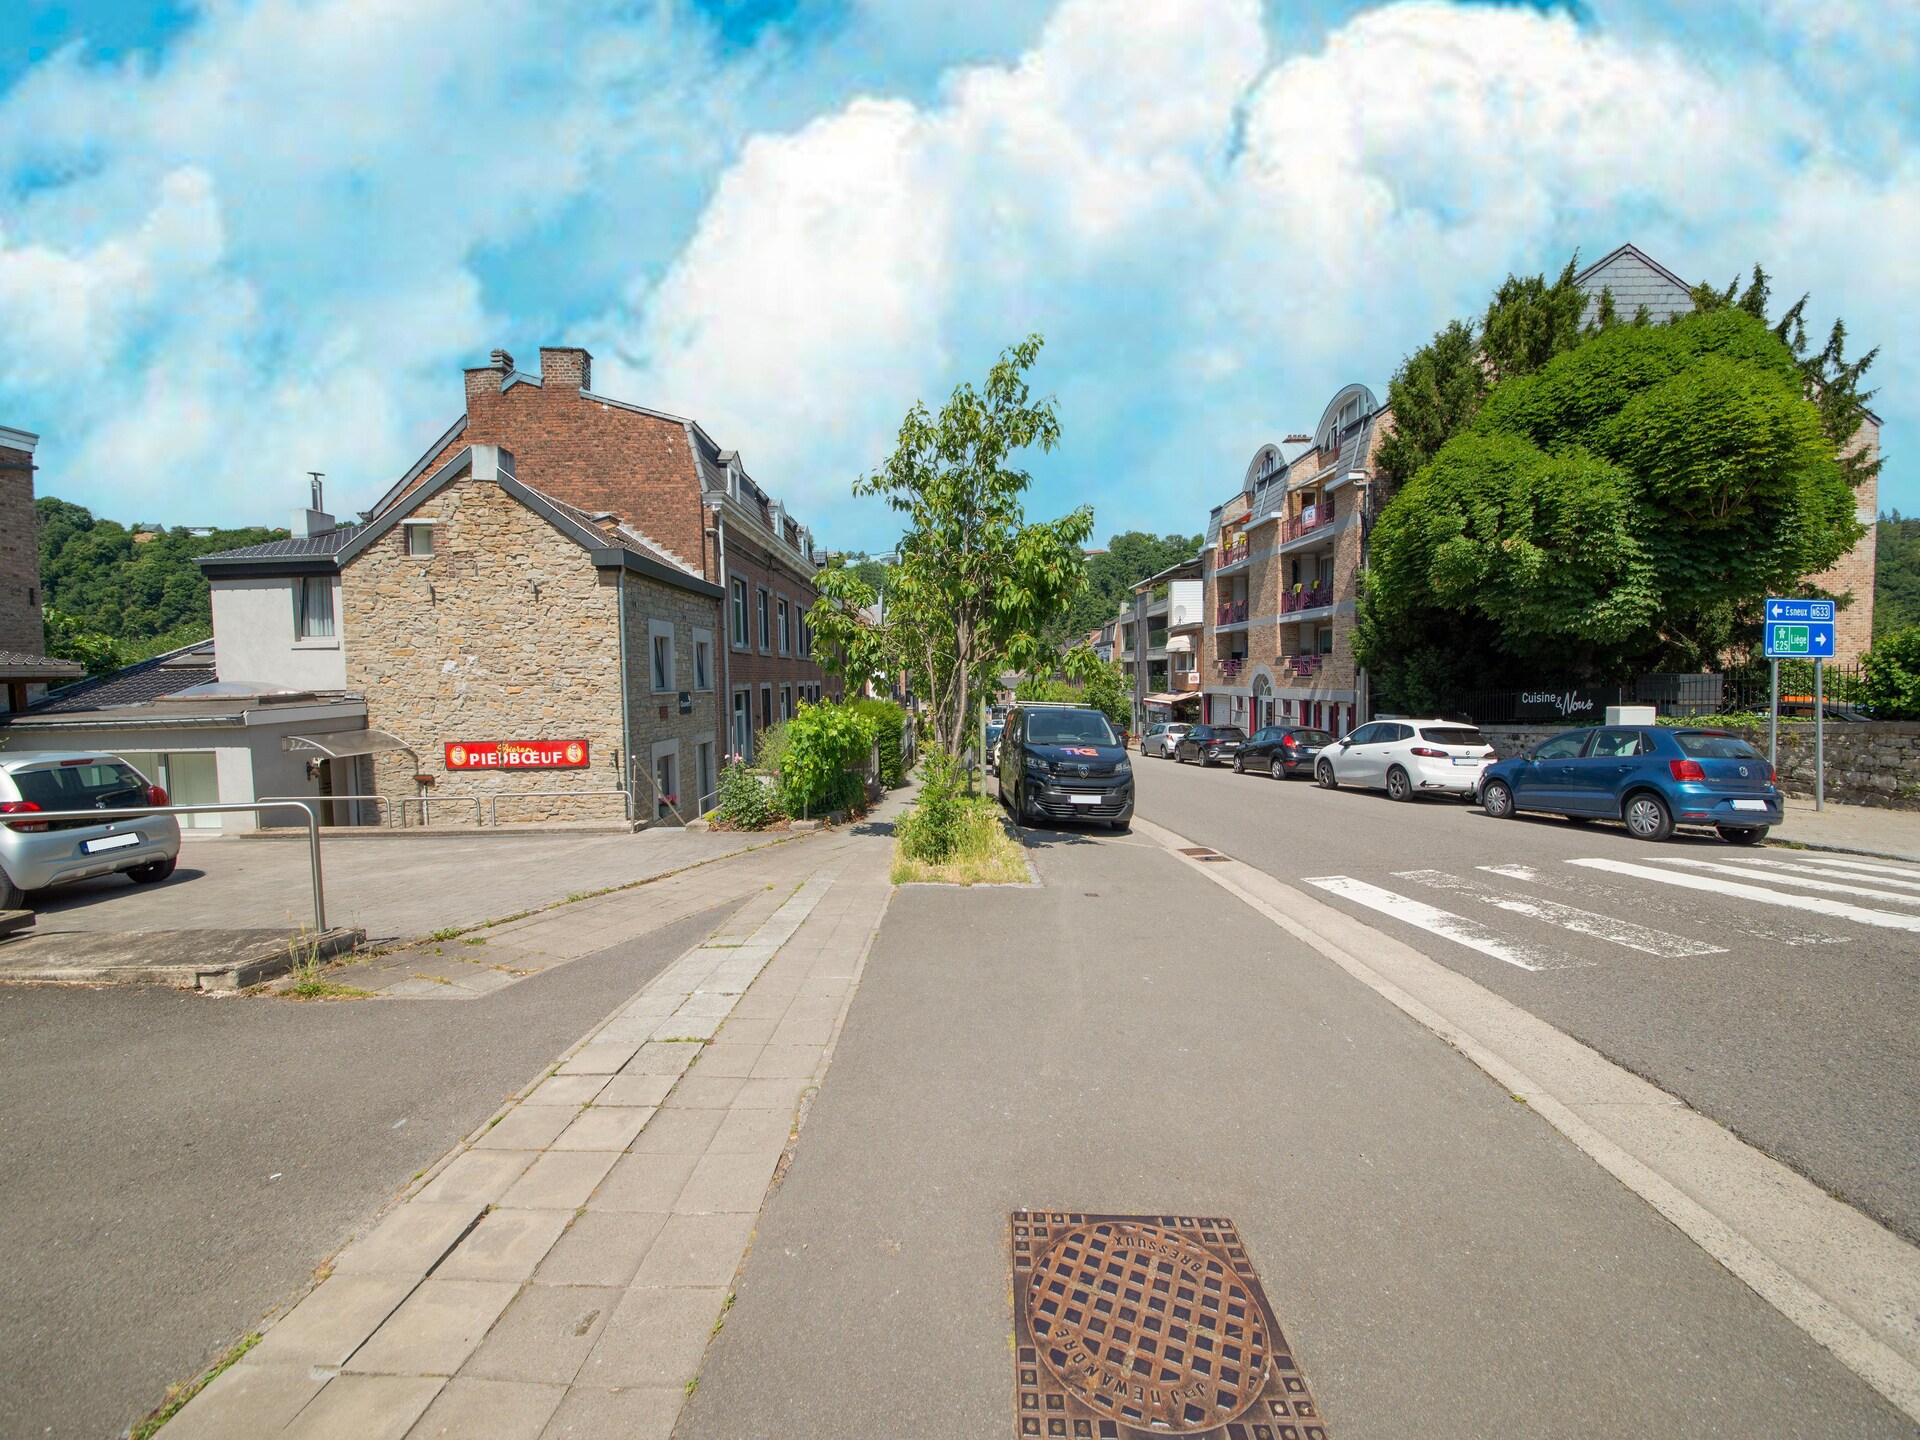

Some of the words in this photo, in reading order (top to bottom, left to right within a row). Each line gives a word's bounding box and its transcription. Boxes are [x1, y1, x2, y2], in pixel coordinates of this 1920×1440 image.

[1785, 606, 1808, 617] Esneux
[1812, 606, 1829, 617] N633
[1775, 640, 1789, 651] E25
[1790, 634, 1807, 647] Liège
[1522, 692, 1556, 703] Cuisine
[1555, 697, 1563, 710] &
[1562, 690, 1594, 716] Nous
